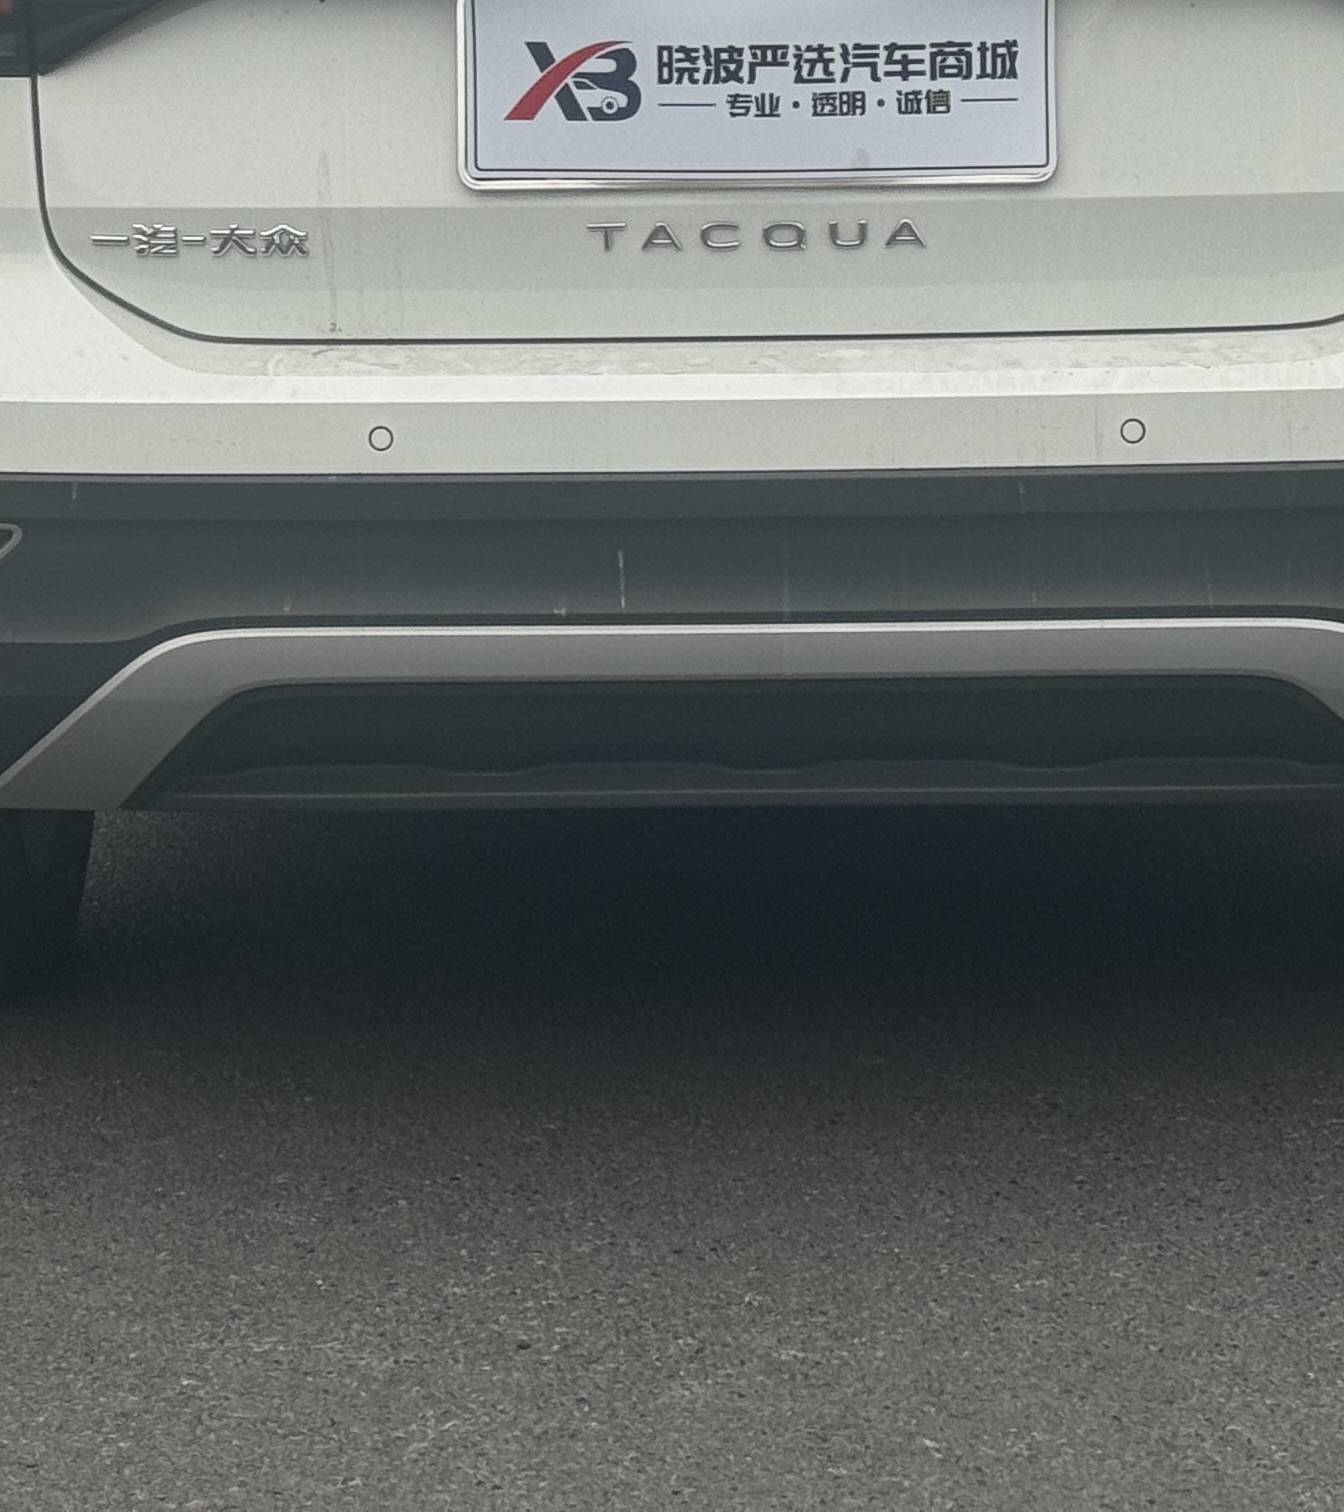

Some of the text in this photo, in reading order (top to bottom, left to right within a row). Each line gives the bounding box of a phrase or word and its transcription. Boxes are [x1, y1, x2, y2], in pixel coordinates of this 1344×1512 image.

[656, 39, 1019, 86] 晓波严选汽车商城
[586, 218, 928, 253] TACQUA
